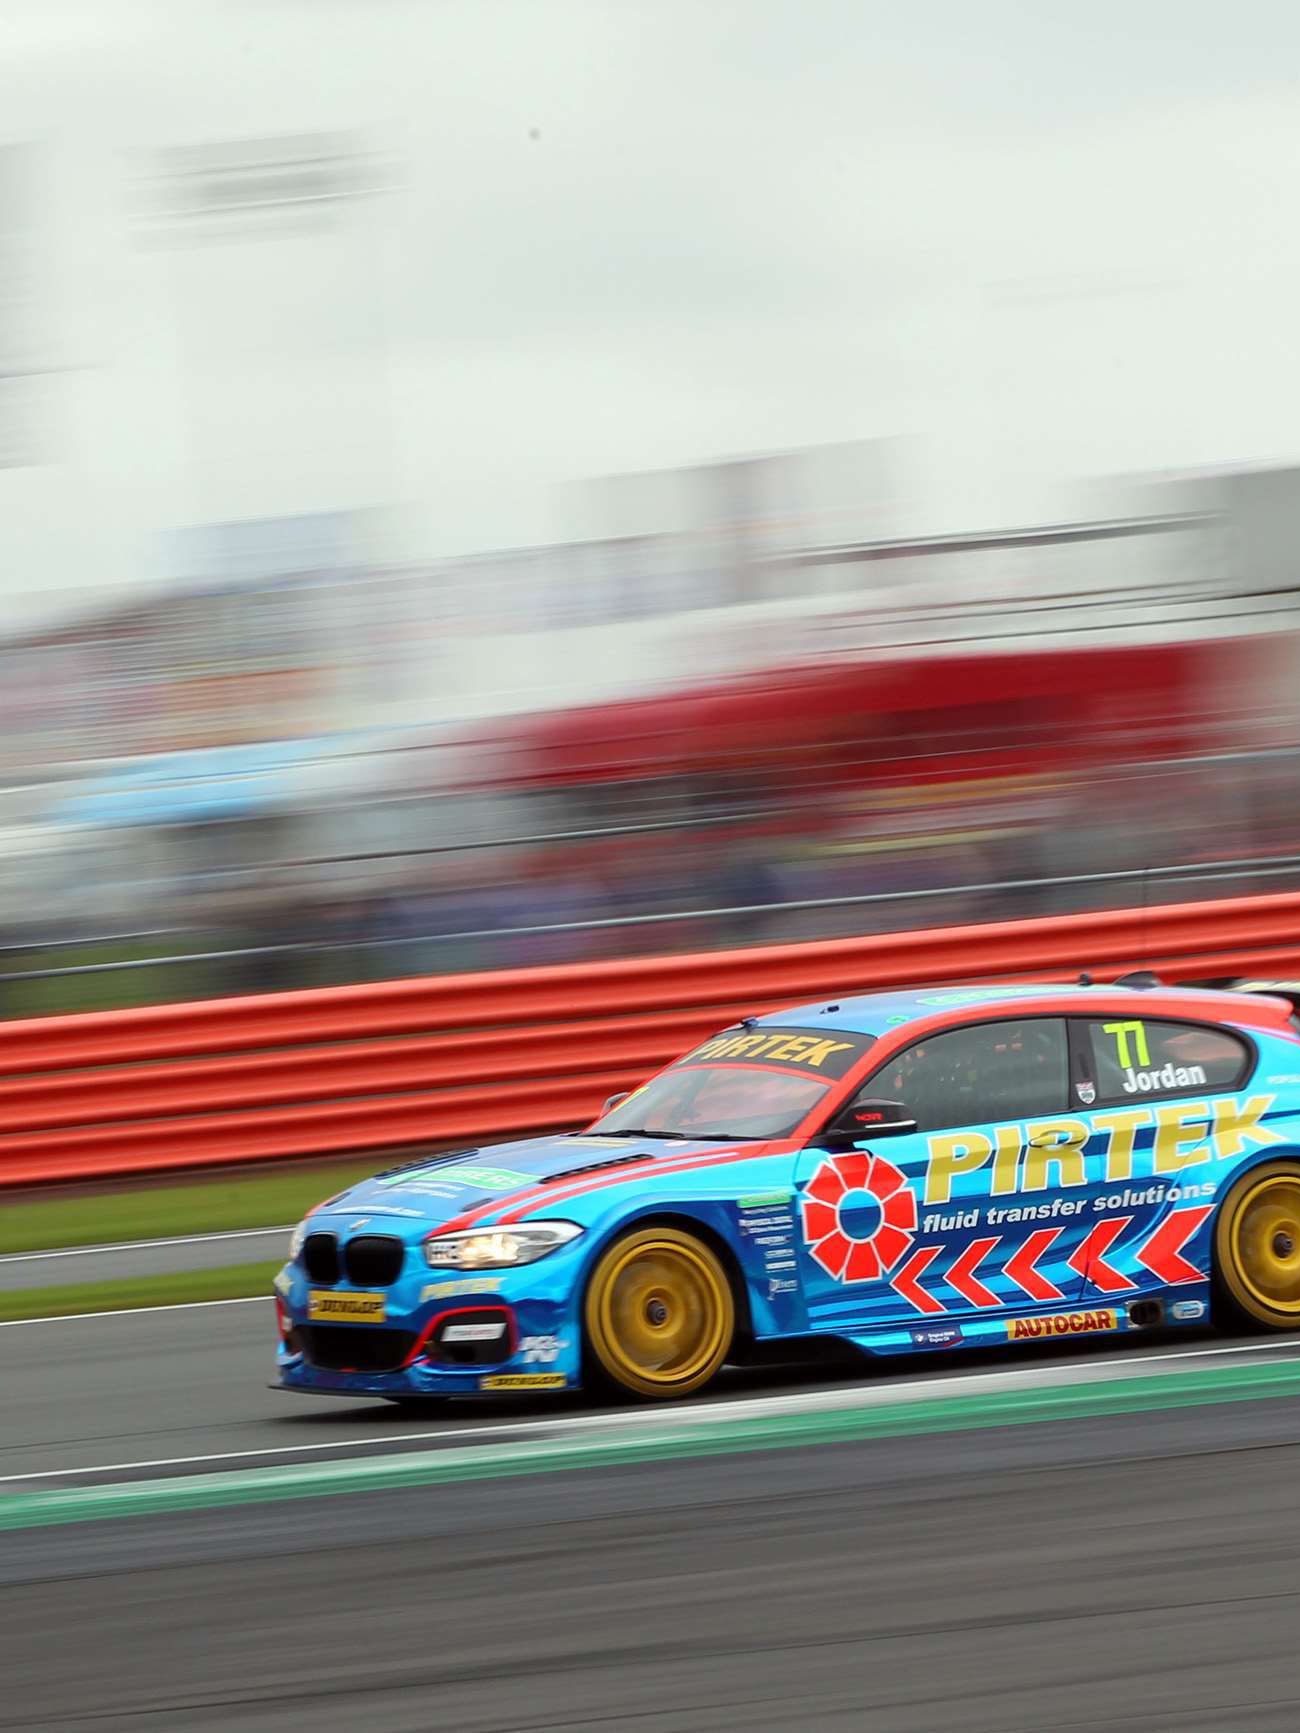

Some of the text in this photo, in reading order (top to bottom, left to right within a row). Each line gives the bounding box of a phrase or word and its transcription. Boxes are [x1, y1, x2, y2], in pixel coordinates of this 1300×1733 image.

[678, 1035, 856, 1068] PIRTEK
[1102, 1020, 1151, 1069] 77
[1122, 1062, 1207, 1093] Jordan
[922, 1094, 1288, 1207] PIRTEK
[923, 1181, 1217, 1234] fluid transfer solutions
[1013, 1309, 1113, 1339] AUTOCAR
